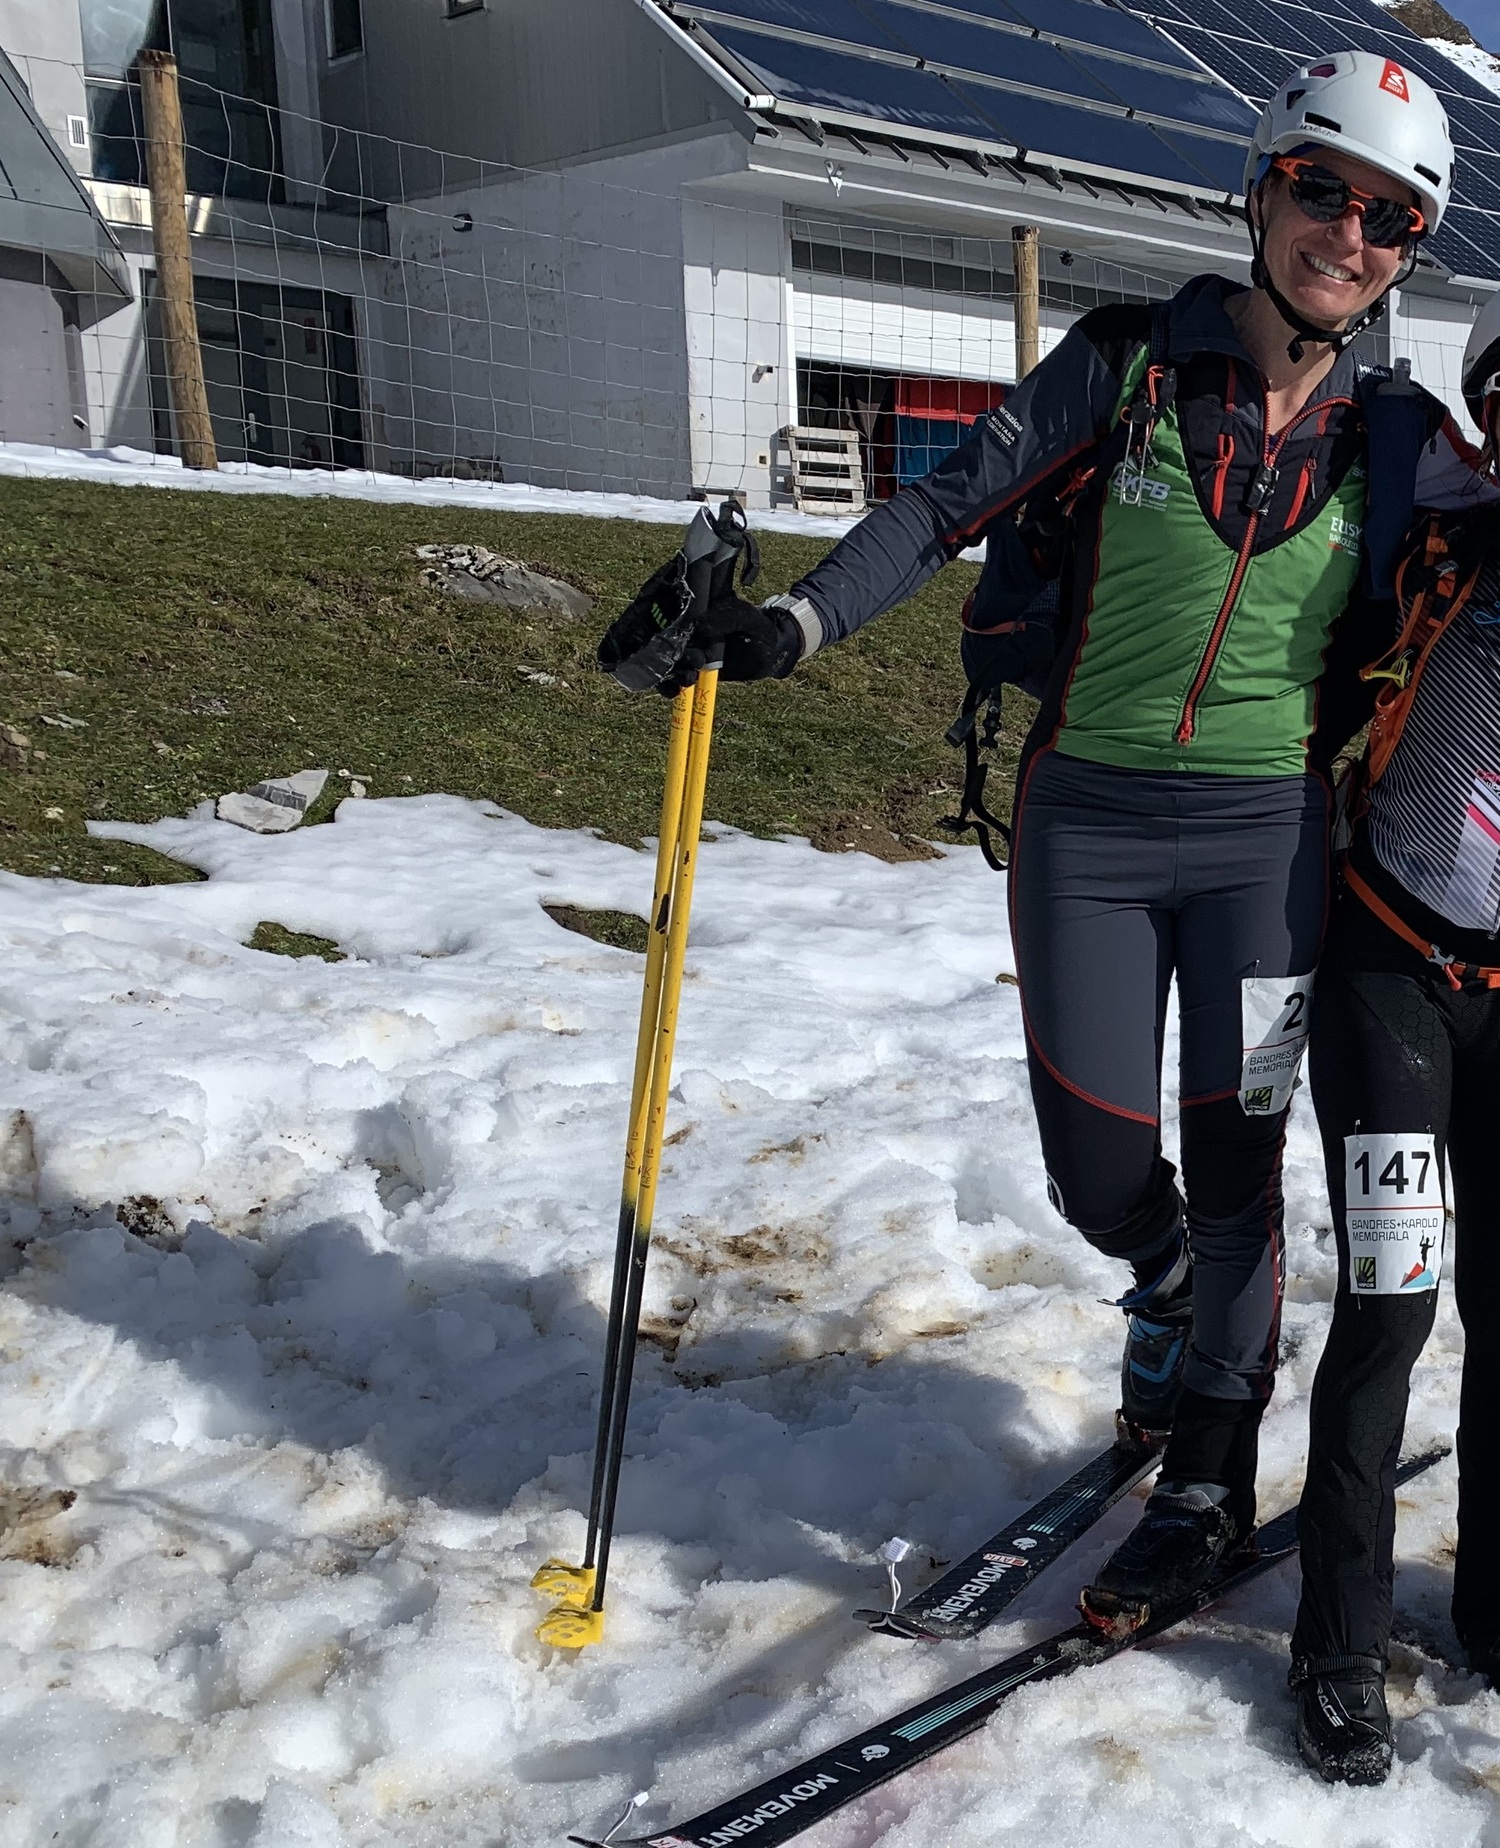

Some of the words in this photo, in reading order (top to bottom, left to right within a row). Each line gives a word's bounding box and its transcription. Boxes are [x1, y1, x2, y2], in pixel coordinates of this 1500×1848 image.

[1282, 991, 1305, 1032] 2
[1354, 1150, 1431, 1196] 147
[1352, 1230, 1410, 1242] MEMORIALA
